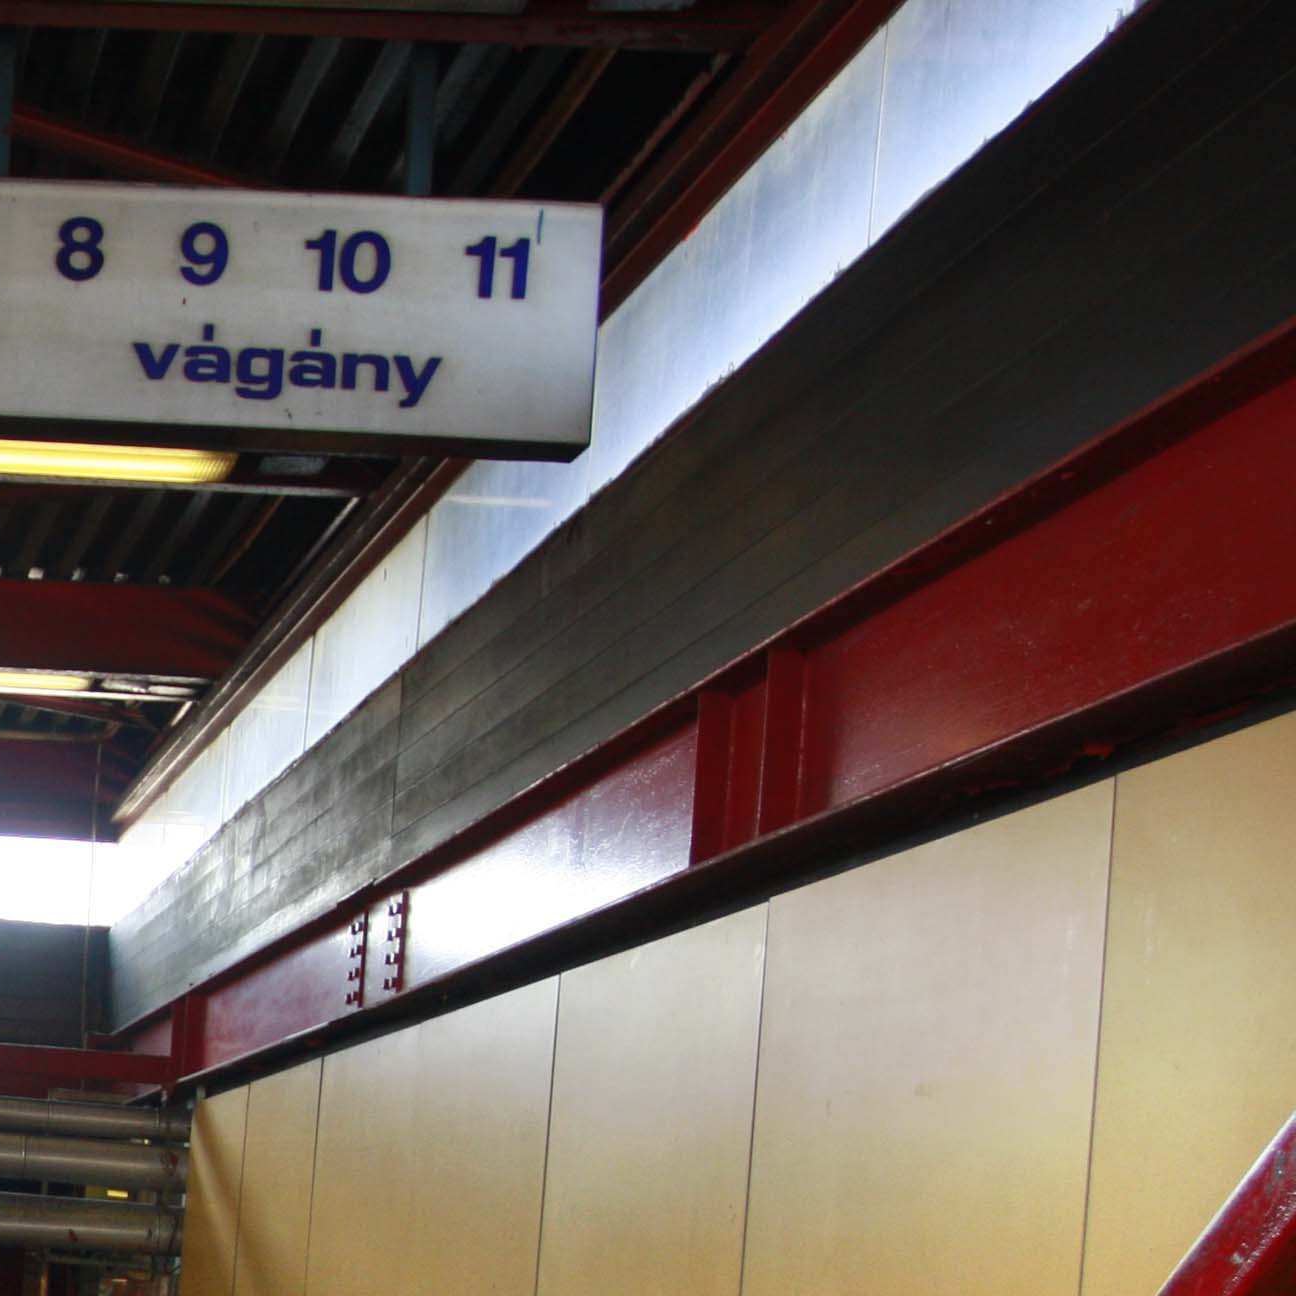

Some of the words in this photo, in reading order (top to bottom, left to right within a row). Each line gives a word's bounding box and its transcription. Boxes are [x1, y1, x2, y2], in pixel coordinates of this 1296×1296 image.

[54, 214, 106, 283] 8
[179, 220, 231, 288] 9
[304, 227, 393, 296] 10
[464, 234, 532, 301] 11
[131, 322, 444, 409] vágány
